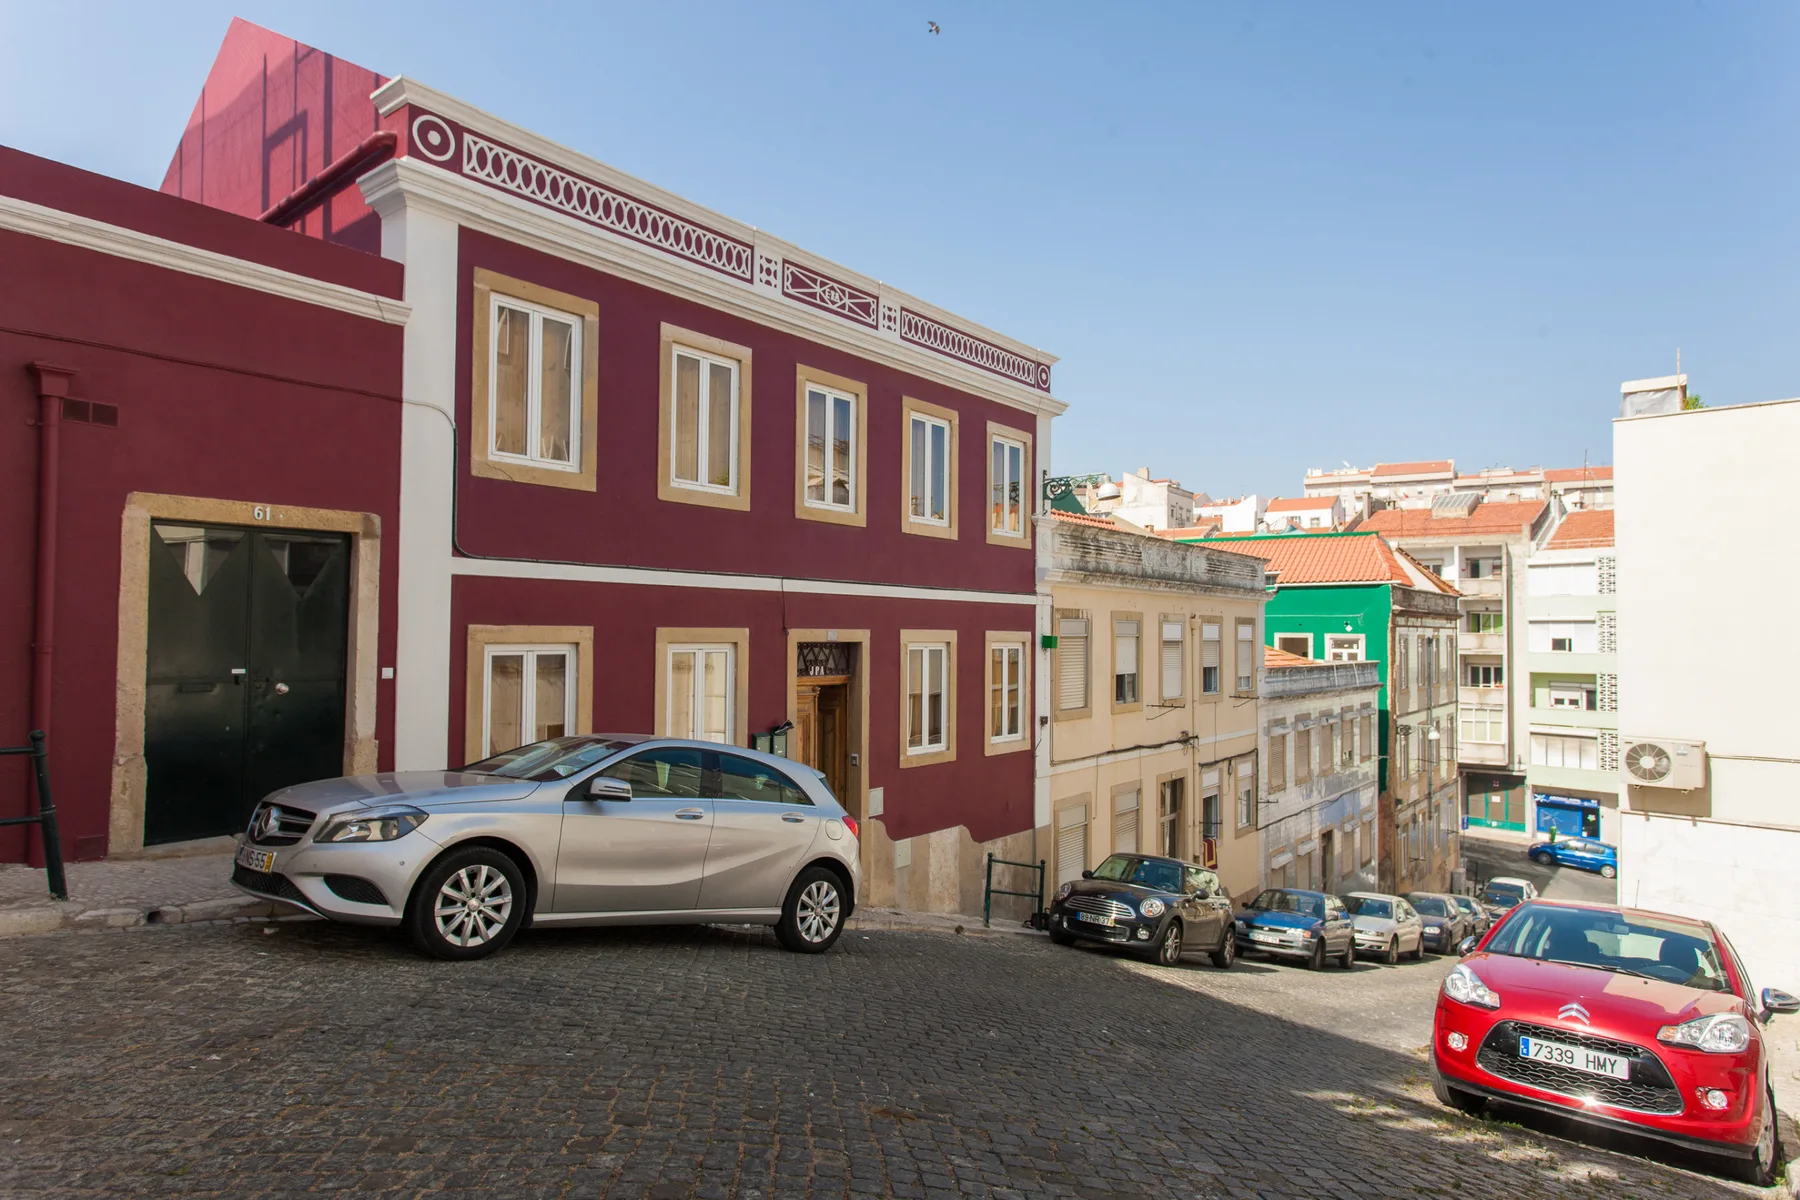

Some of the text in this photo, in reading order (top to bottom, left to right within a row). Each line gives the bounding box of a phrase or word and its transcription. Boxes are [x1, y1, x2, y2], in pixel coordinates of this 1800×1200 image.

[254, 506, 271, 521] 61
[1533, 1042, 1617, 1074] 7339 HMY
